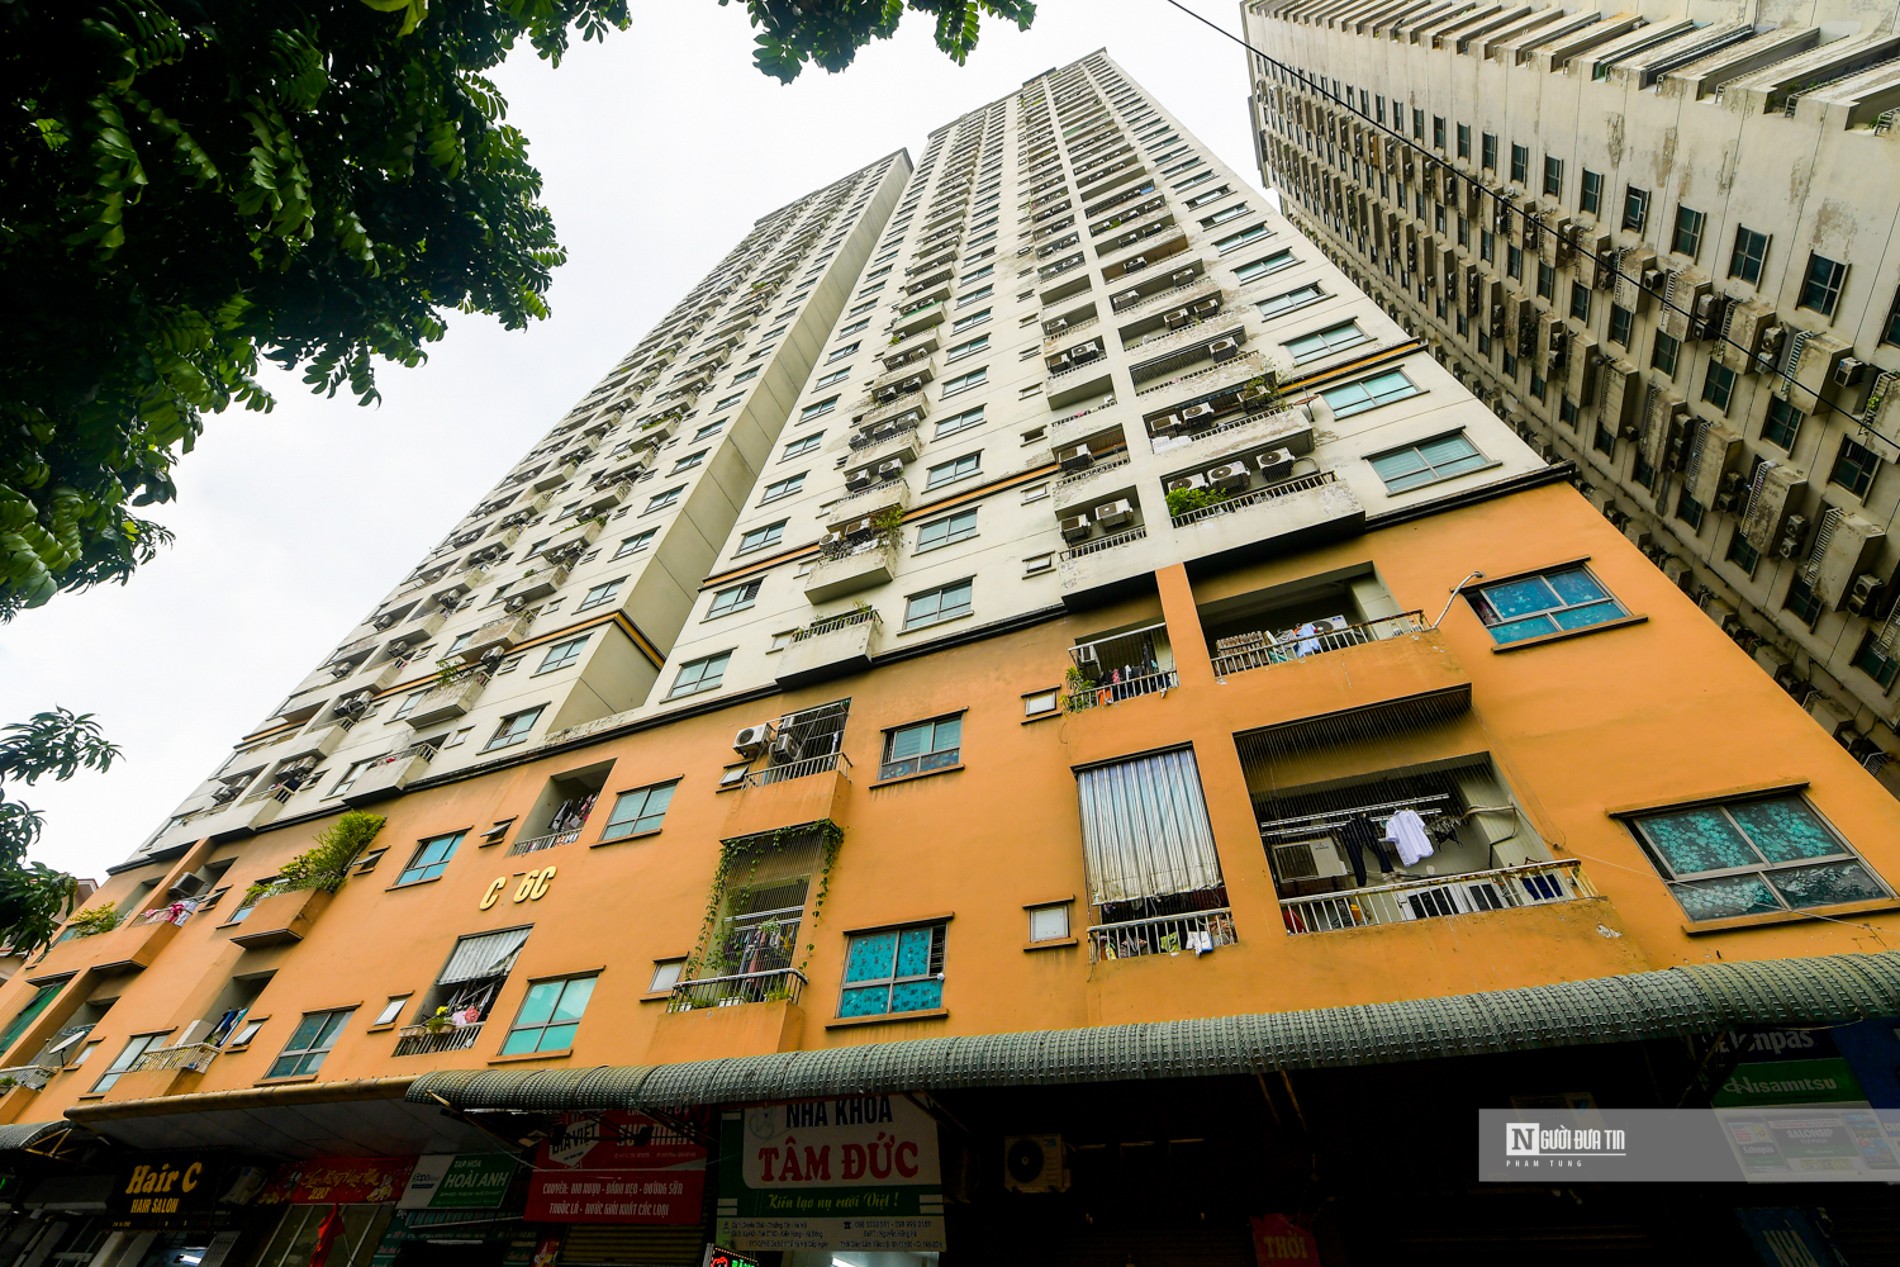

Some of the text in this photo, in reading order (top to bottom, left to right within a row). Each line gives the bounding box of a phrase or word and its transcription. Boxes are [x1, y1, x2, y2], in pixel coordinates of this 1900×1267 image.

[479, 865, 557, 911] C 6C
[1722, 1076, 1838, 1094] Hisamitsu
[758, 1132, 919, 1182] TÂM ĐỨC
[125, 1161, 204, 1194] Hair C
[444, 1170, 479, 1188] HOÀI
[476, 1171, 510, 1187] ANH
[130, 1198, 180, 1213] HAIR SALON
[862, 1191, 890, 1211] Việt
